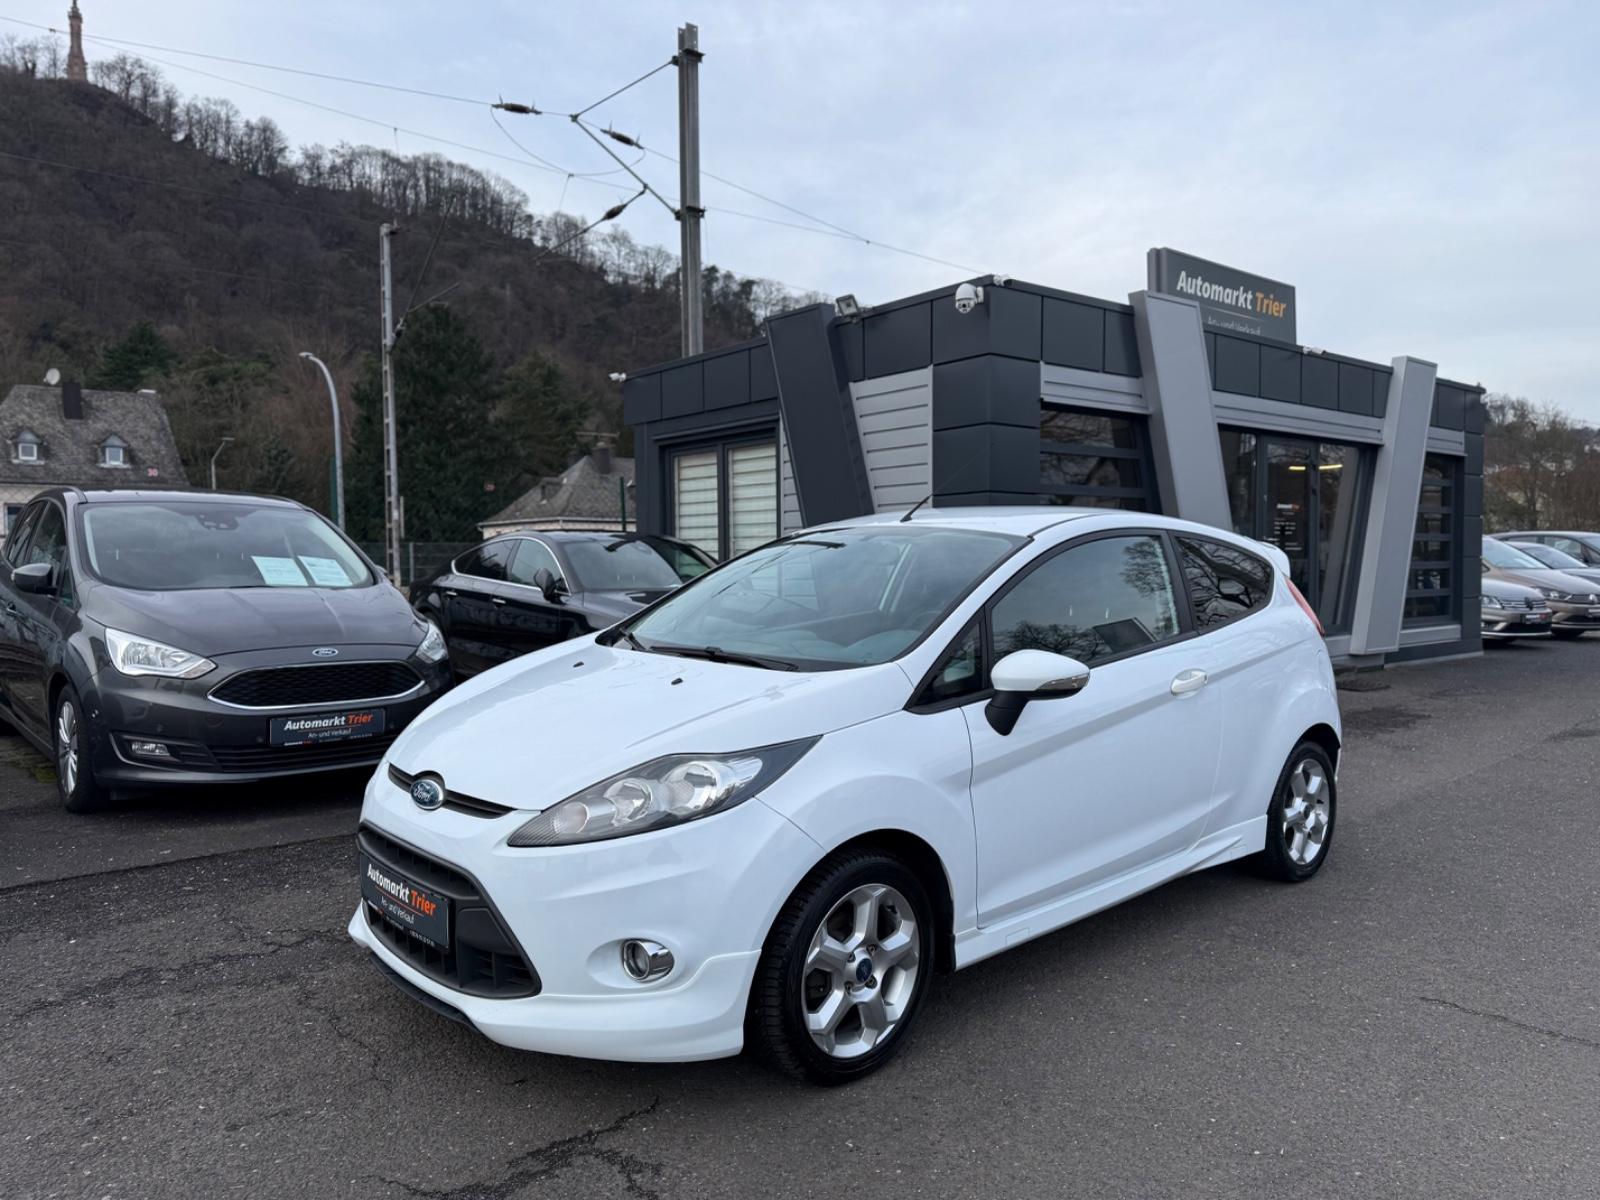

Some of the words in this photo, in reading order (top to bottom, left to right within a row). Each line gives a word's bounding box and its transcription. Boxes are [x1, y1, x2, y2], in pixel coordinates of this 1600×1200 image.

[1176, 270, 1253, 310] Automarkt
[1255, 291, 1287, 318] Trier
[284, 716, 346, 730] Automarkt
[347, 713, 374, 725] Trier
[319, 730, 330, 738] und
[413, 782, 435, 802] Ford
[367, 863, 410, 903] Automarkt
[410, 889, 436, 916] Trier
